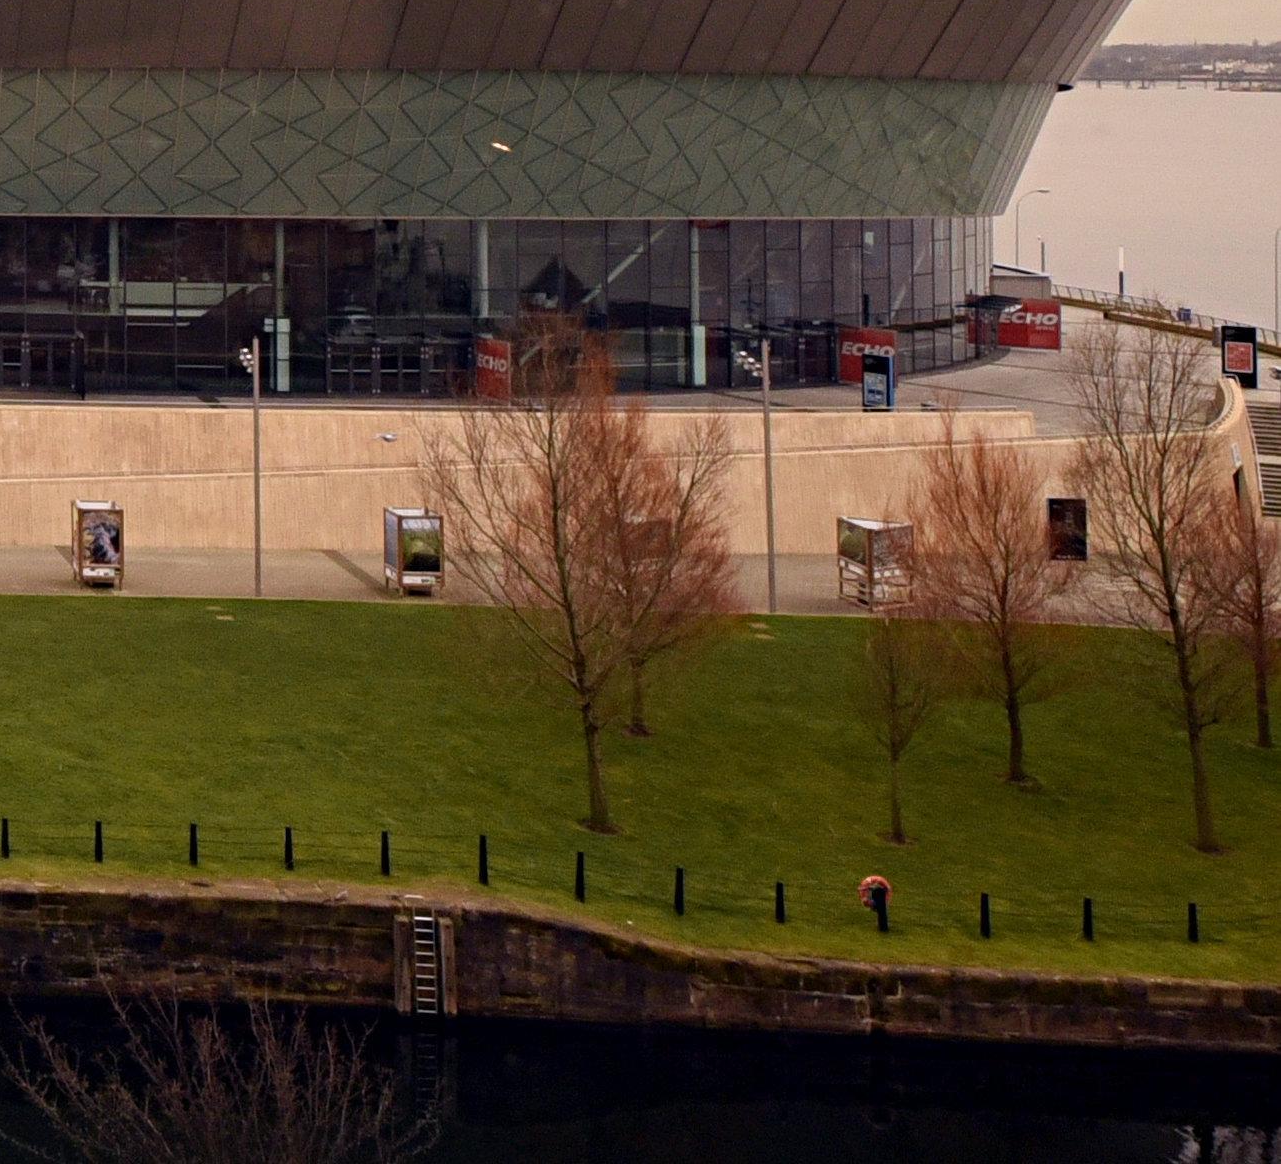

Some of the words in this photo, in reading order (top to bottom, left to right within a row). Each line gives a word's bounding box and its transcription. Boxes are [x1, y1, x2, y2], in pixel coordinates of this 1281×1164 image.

[999, 312, 1058, 325] ECHO
[841, 341, 895, 356] ECHO
[477, 353, 507, 372] ECHO
